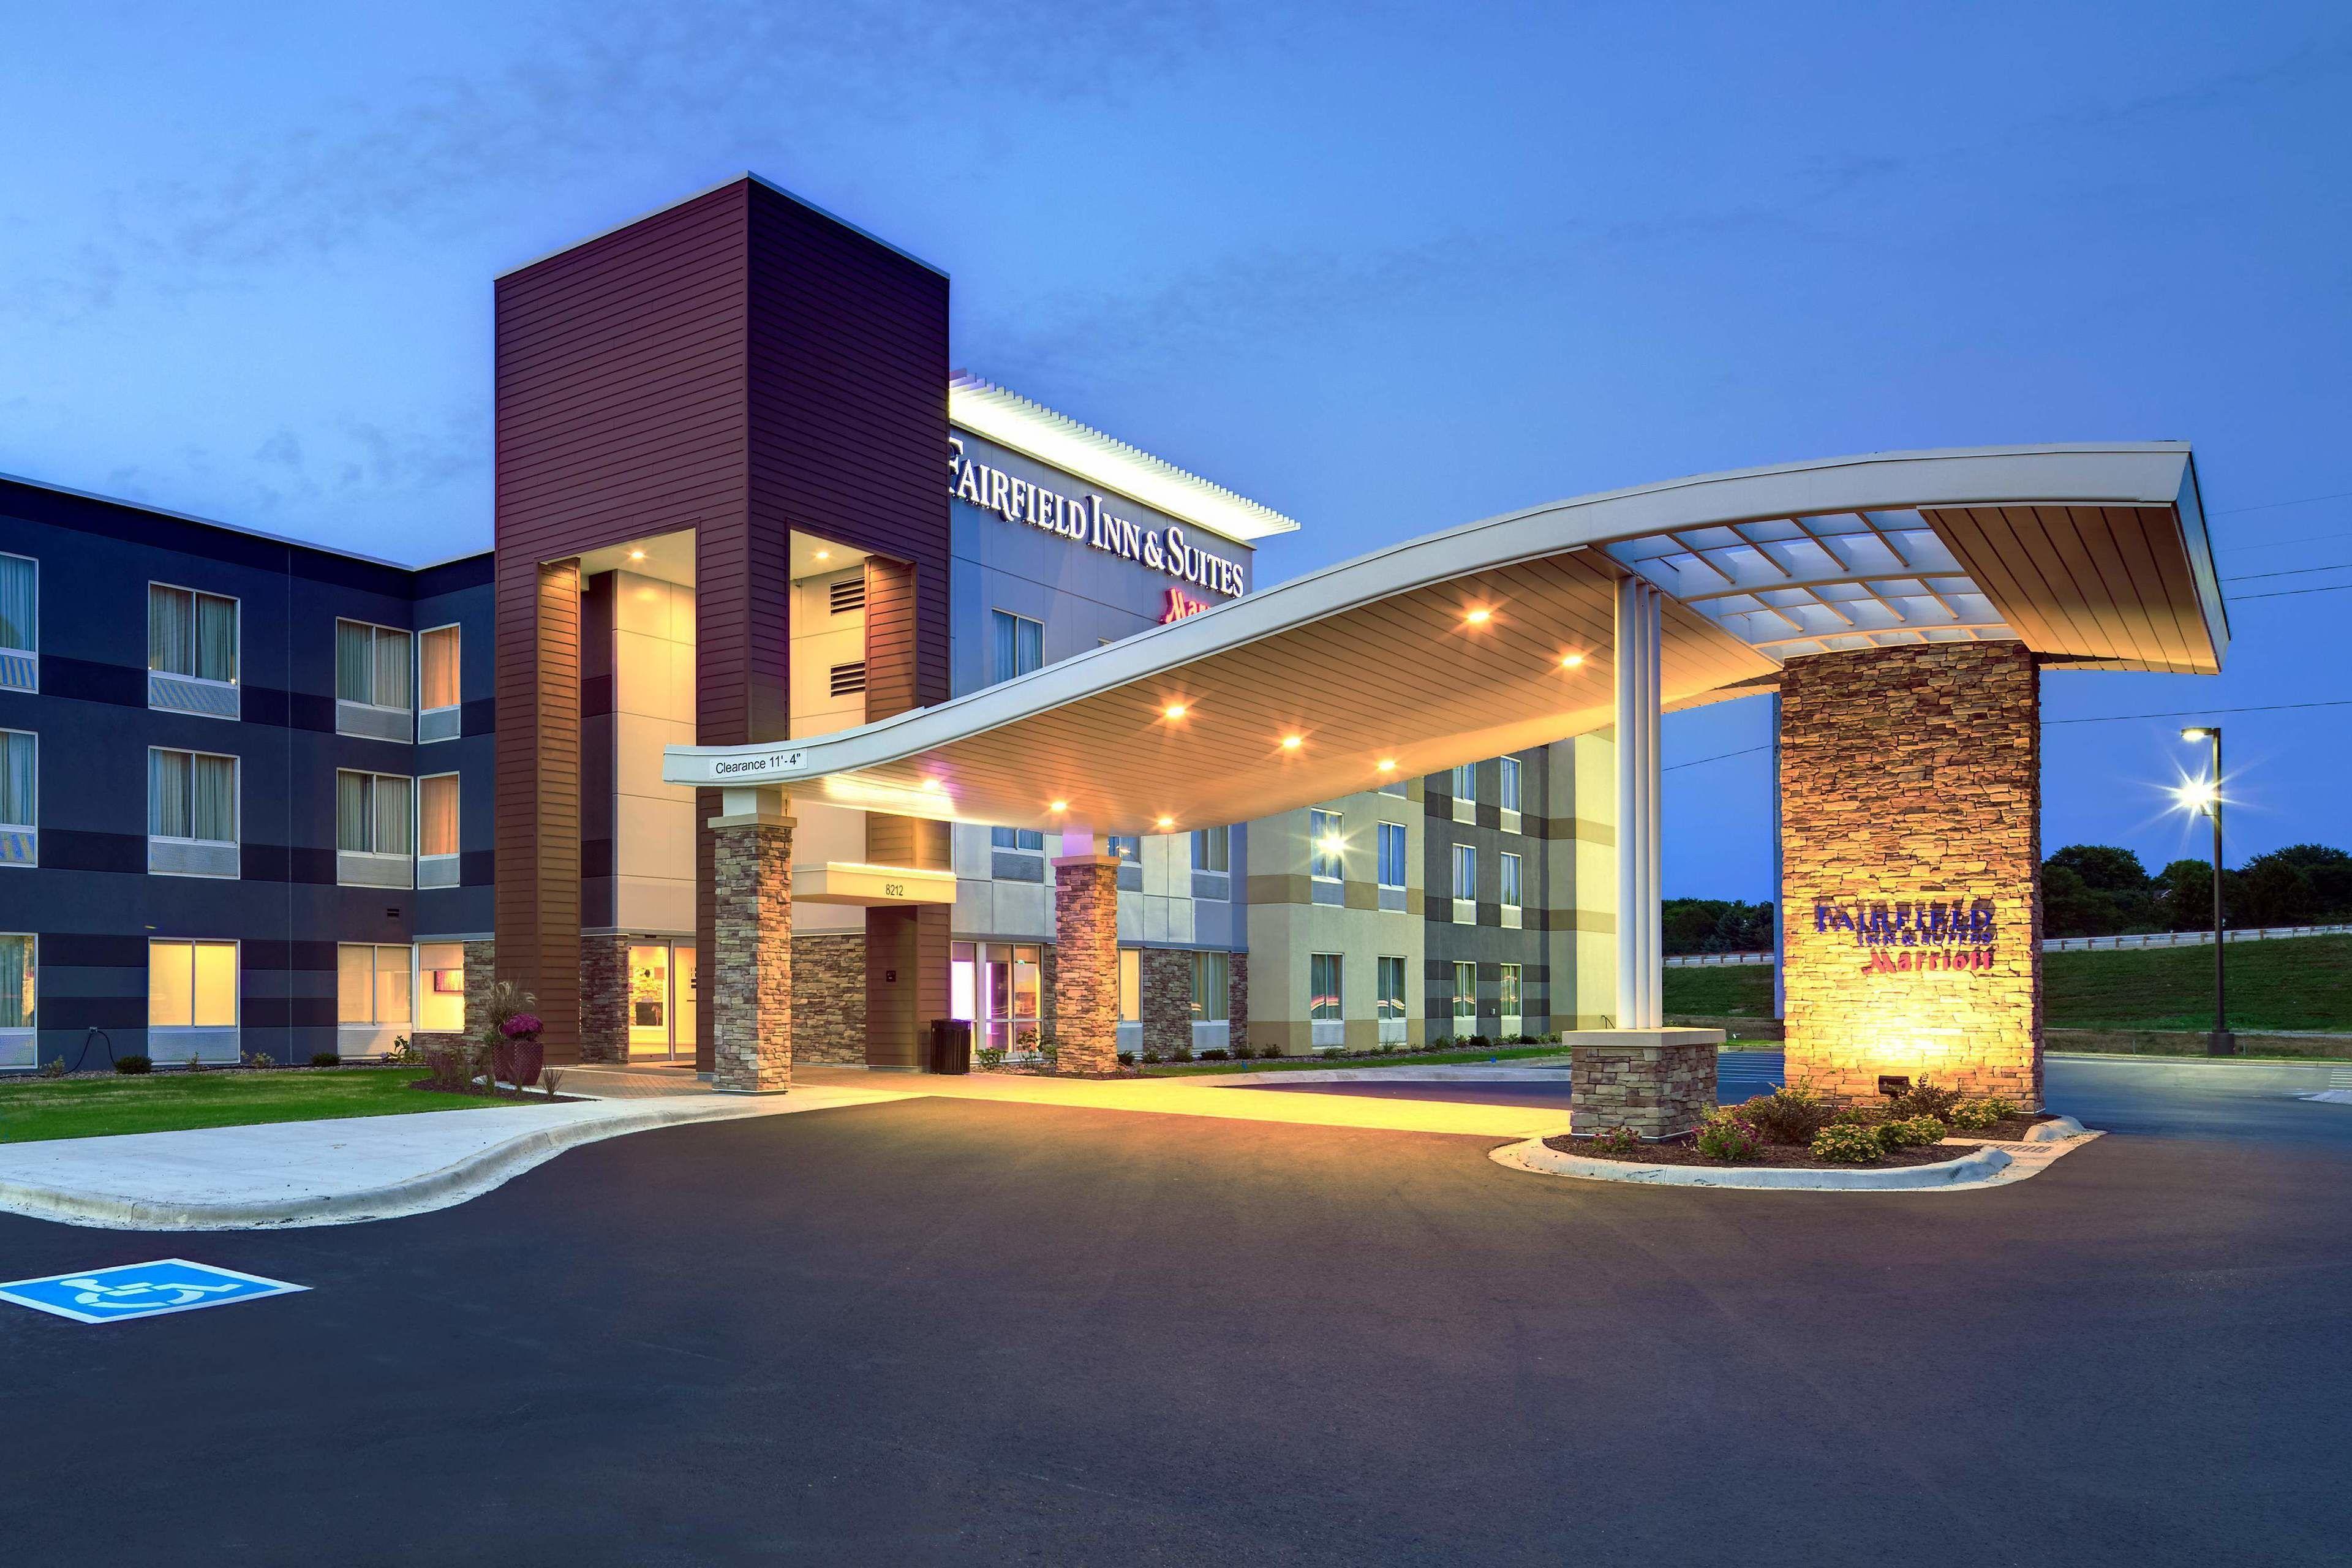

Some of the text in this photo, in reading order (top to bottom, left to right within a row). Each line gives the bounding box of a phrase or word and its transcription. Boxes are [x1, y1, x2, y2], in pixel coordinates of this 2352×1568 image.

[1090, 494, 1141, 560] INN
[1144, 530, 1166, 570] &
[1166, 526, 1245, 598] SUITES
[715, 760, 766, 774] Clearance
[886, 883, 904, 896] 8212
[1817, 905, 1992, 935] FAIRFIELD
[1858, 933, 1991, 946] INN & SUITES
[1861, 951, 1992, 975] Marriott
